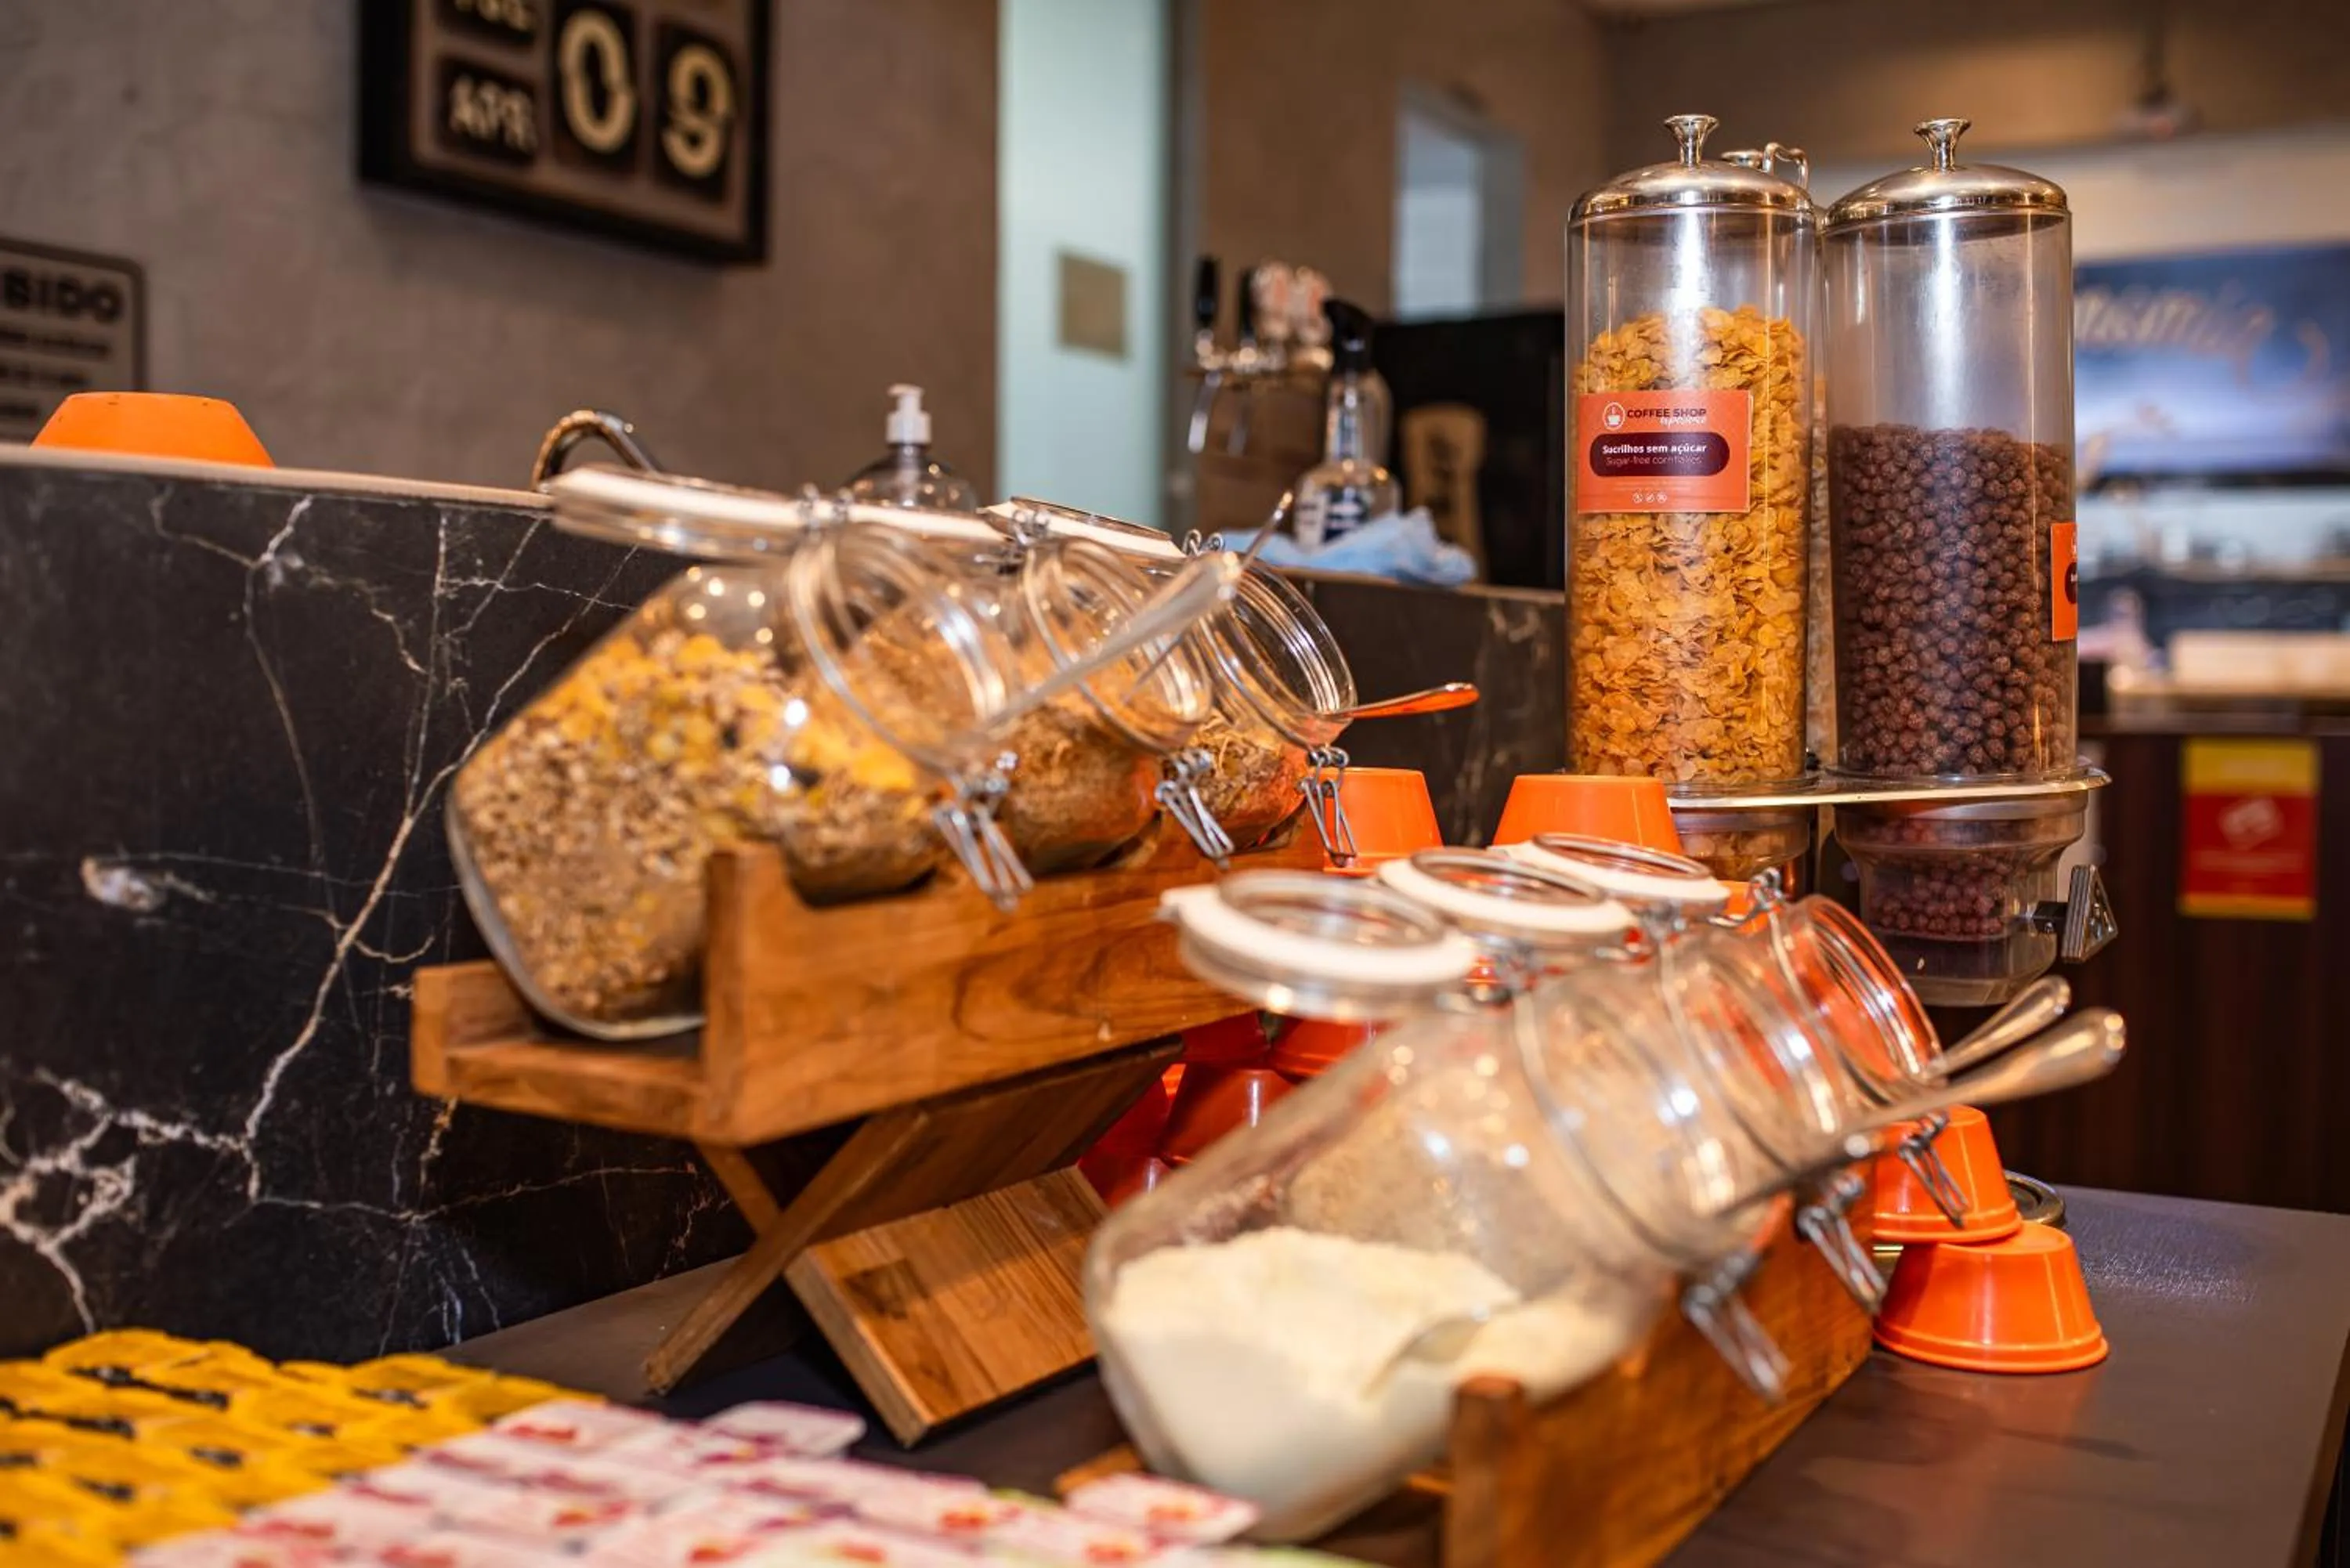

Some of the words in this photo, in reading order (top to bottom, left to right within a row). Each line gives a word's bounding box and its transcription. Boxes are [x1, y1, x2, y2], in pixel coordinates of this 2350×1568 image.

[1627, 408, 1670, 417] COFFEE
[1673, 408, 1707, 417] SHOP
[1602, 444, 1644, 453] Sucrilhos
[1671, 443, 1707, 454] açúcar
